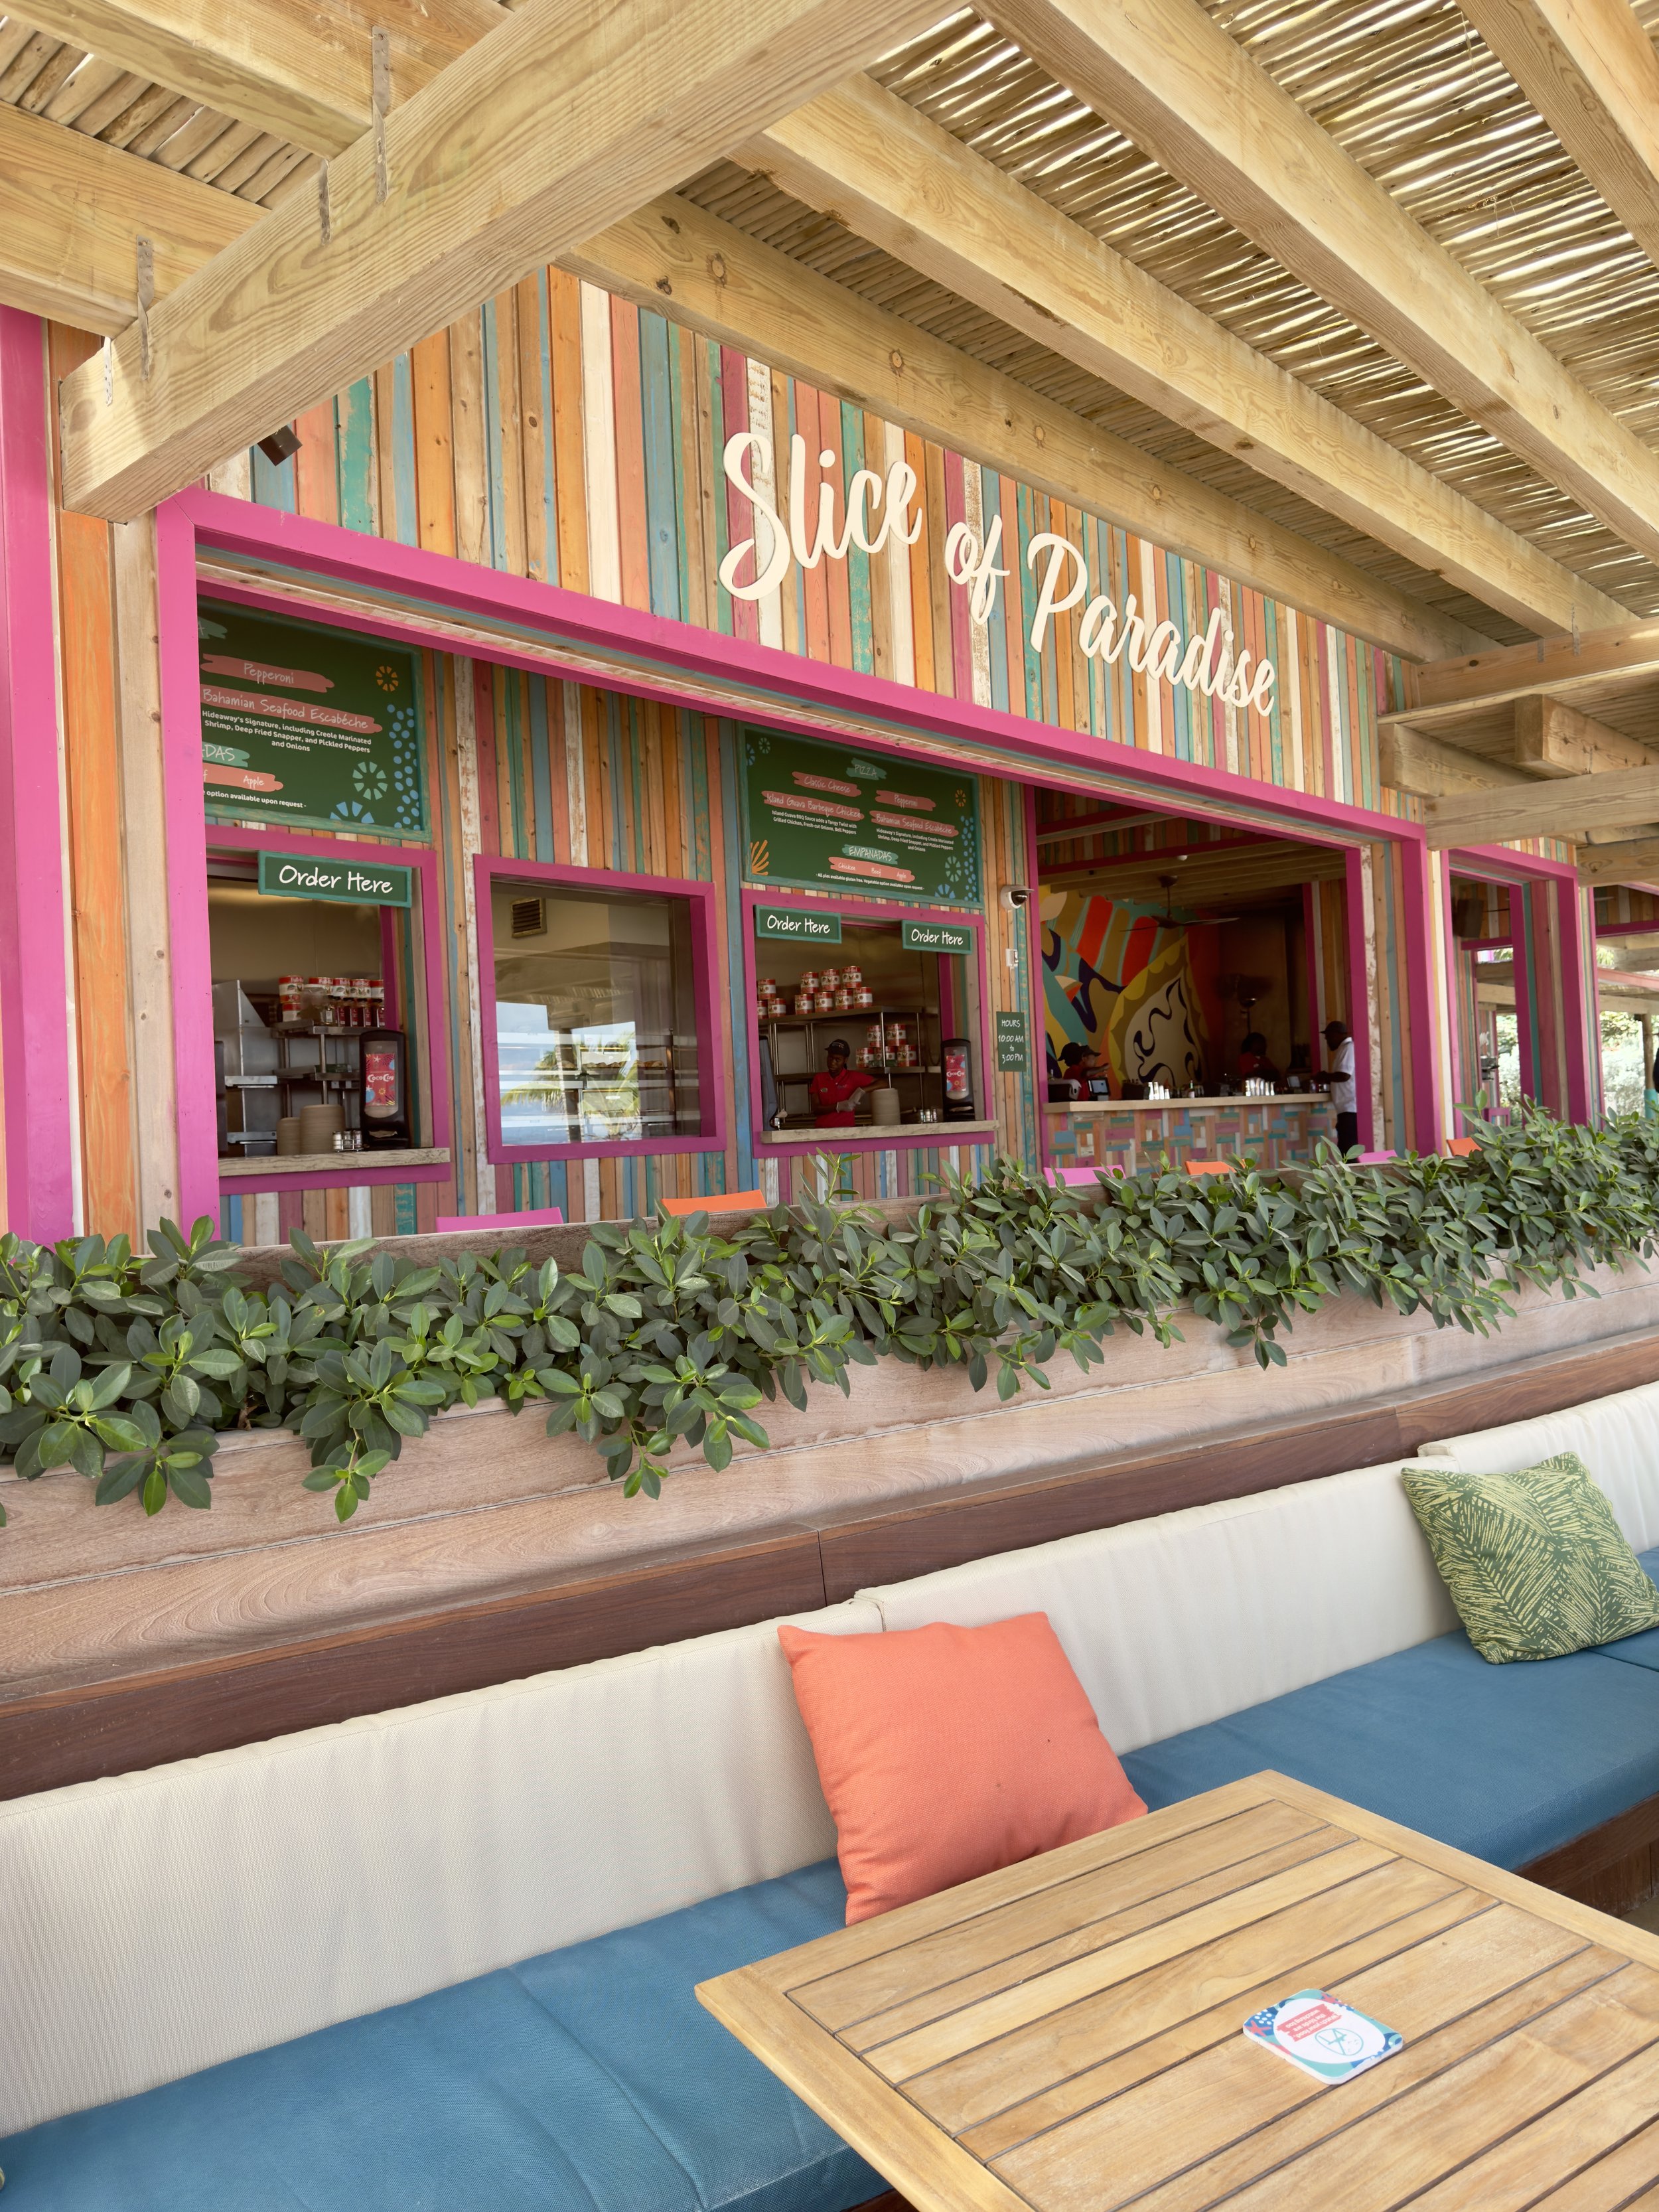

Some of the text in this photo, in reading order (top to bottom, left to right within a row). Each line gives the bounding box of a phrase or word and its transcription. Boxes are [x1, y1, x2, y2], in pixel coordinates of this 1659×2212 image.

[718, 432, 1275, 717] Slice of Paradise
[244, 663, 294, 684] Pepperoni
[202, 689, 254, 709] Bahamian
[260, 700, 305, 719] Seafood
[202, 710, 371, 745] Hideaway's Signature, including Creole Marinated
[204, 720, 234, 731] Shrimp,
[234, 725, 253, 734] Deep
[273, 731, 304, 742] Snapper,
[319, 739, 343, 749] Pickled
[344, 743, 370, 753] Peppers
[286, 742, 310, 751] Onions
[855, 764, 877, 776] PIZZA
[243, 775, 264, 788] Apple
[804, 776, 851, 793] Classic Cheese
[230, 794, 260, 803] available
[766, 793, 784, 804] Island
[786, 797, 806, 808] Guava
[836, 806, 861, 818] Chicken
[849, 846, 892, 861] EMPANADAS
[279, 865, 393, 893] Order Here
[871, 867, 881, 877] Beef
[767, 915, 830, 934] Order Here
[911, 928, 964, 946] Order Here
[1001, 1019, 1021, 1028] HOURS
[1001, 1054, 1014, 1065] 3:00
[367, 1073, 394, 1082] CocoCay
